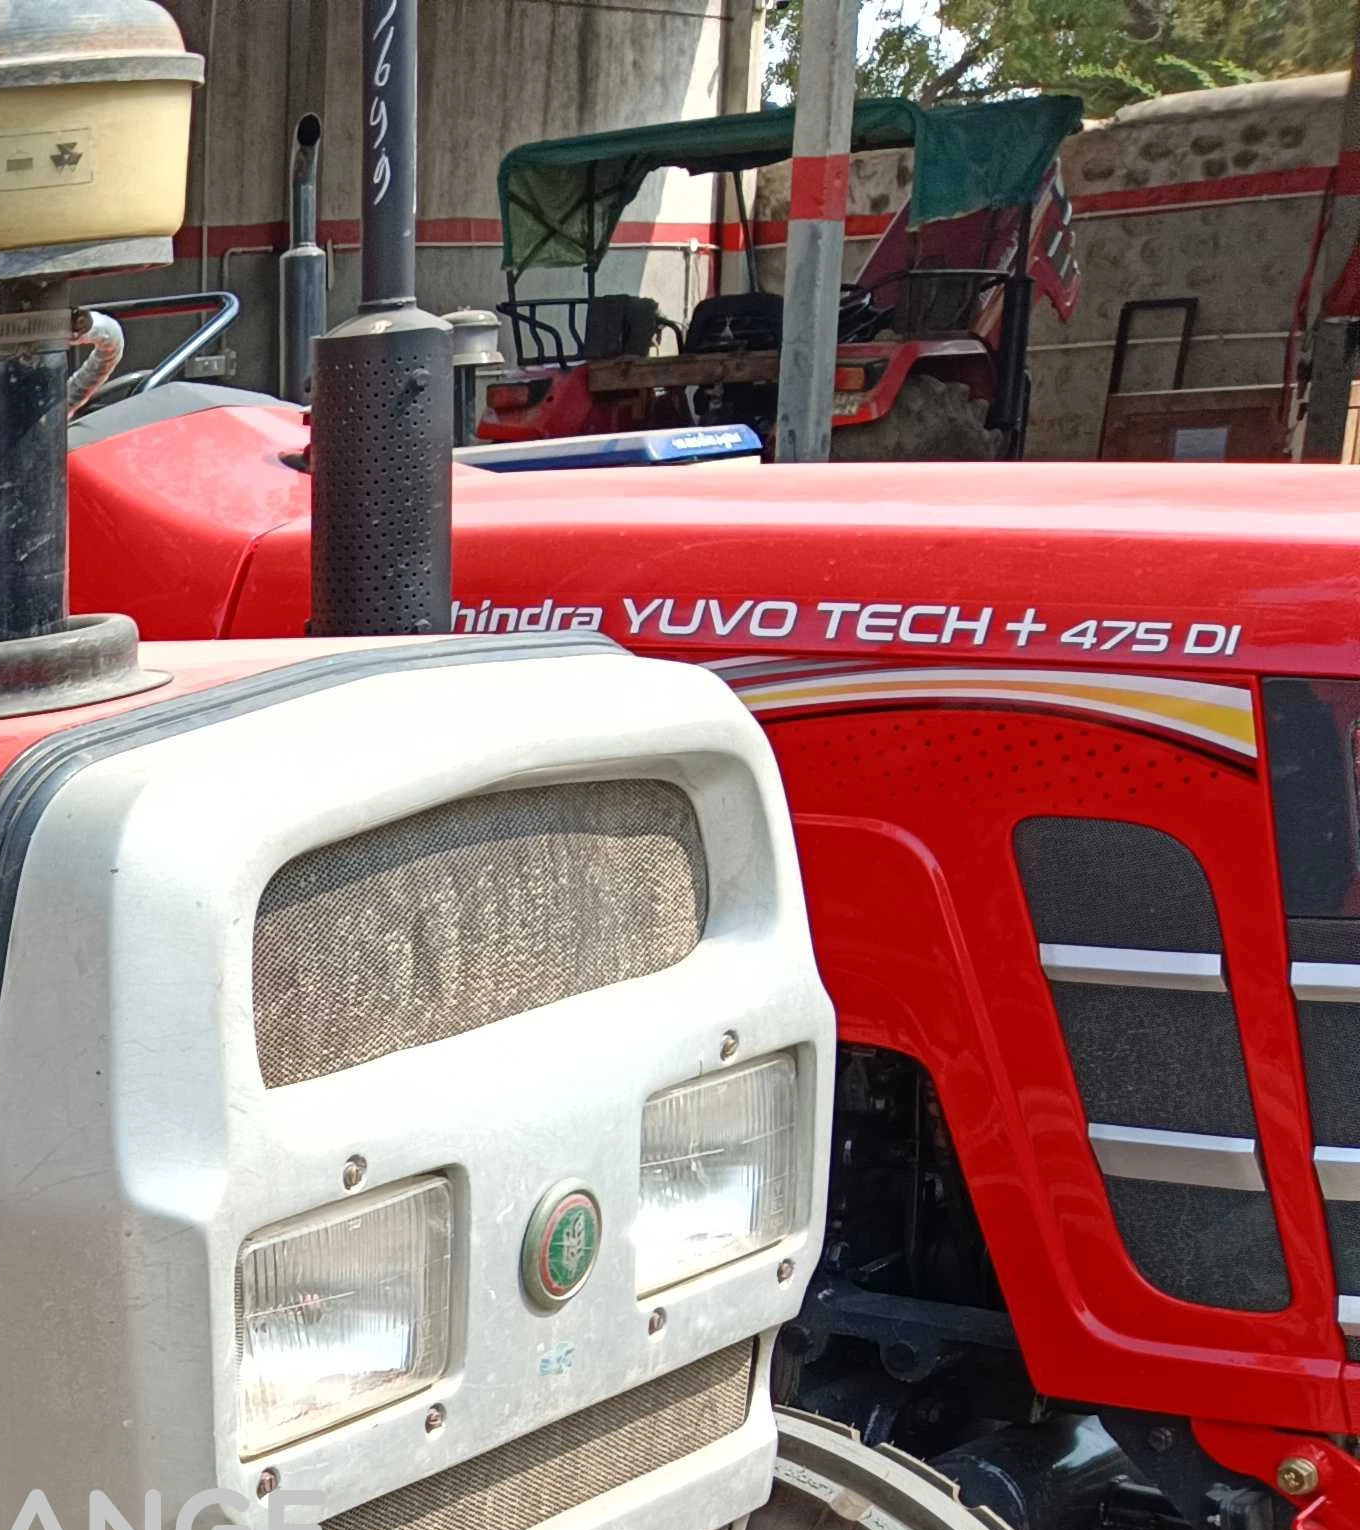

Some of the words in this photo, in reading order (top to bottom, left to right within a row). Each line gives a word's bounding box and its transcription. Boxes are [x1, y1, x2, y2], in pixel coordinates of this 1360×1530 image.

[450, 598, 604, 633] hindra
[621, 597, 798, 638] YUVO
[816, 601, 994, 646] TECH
[1006, 607, 1047, 647] +
[1060, 618, 1173, 653] 475
[1183, 623, 1243, 657] DI
